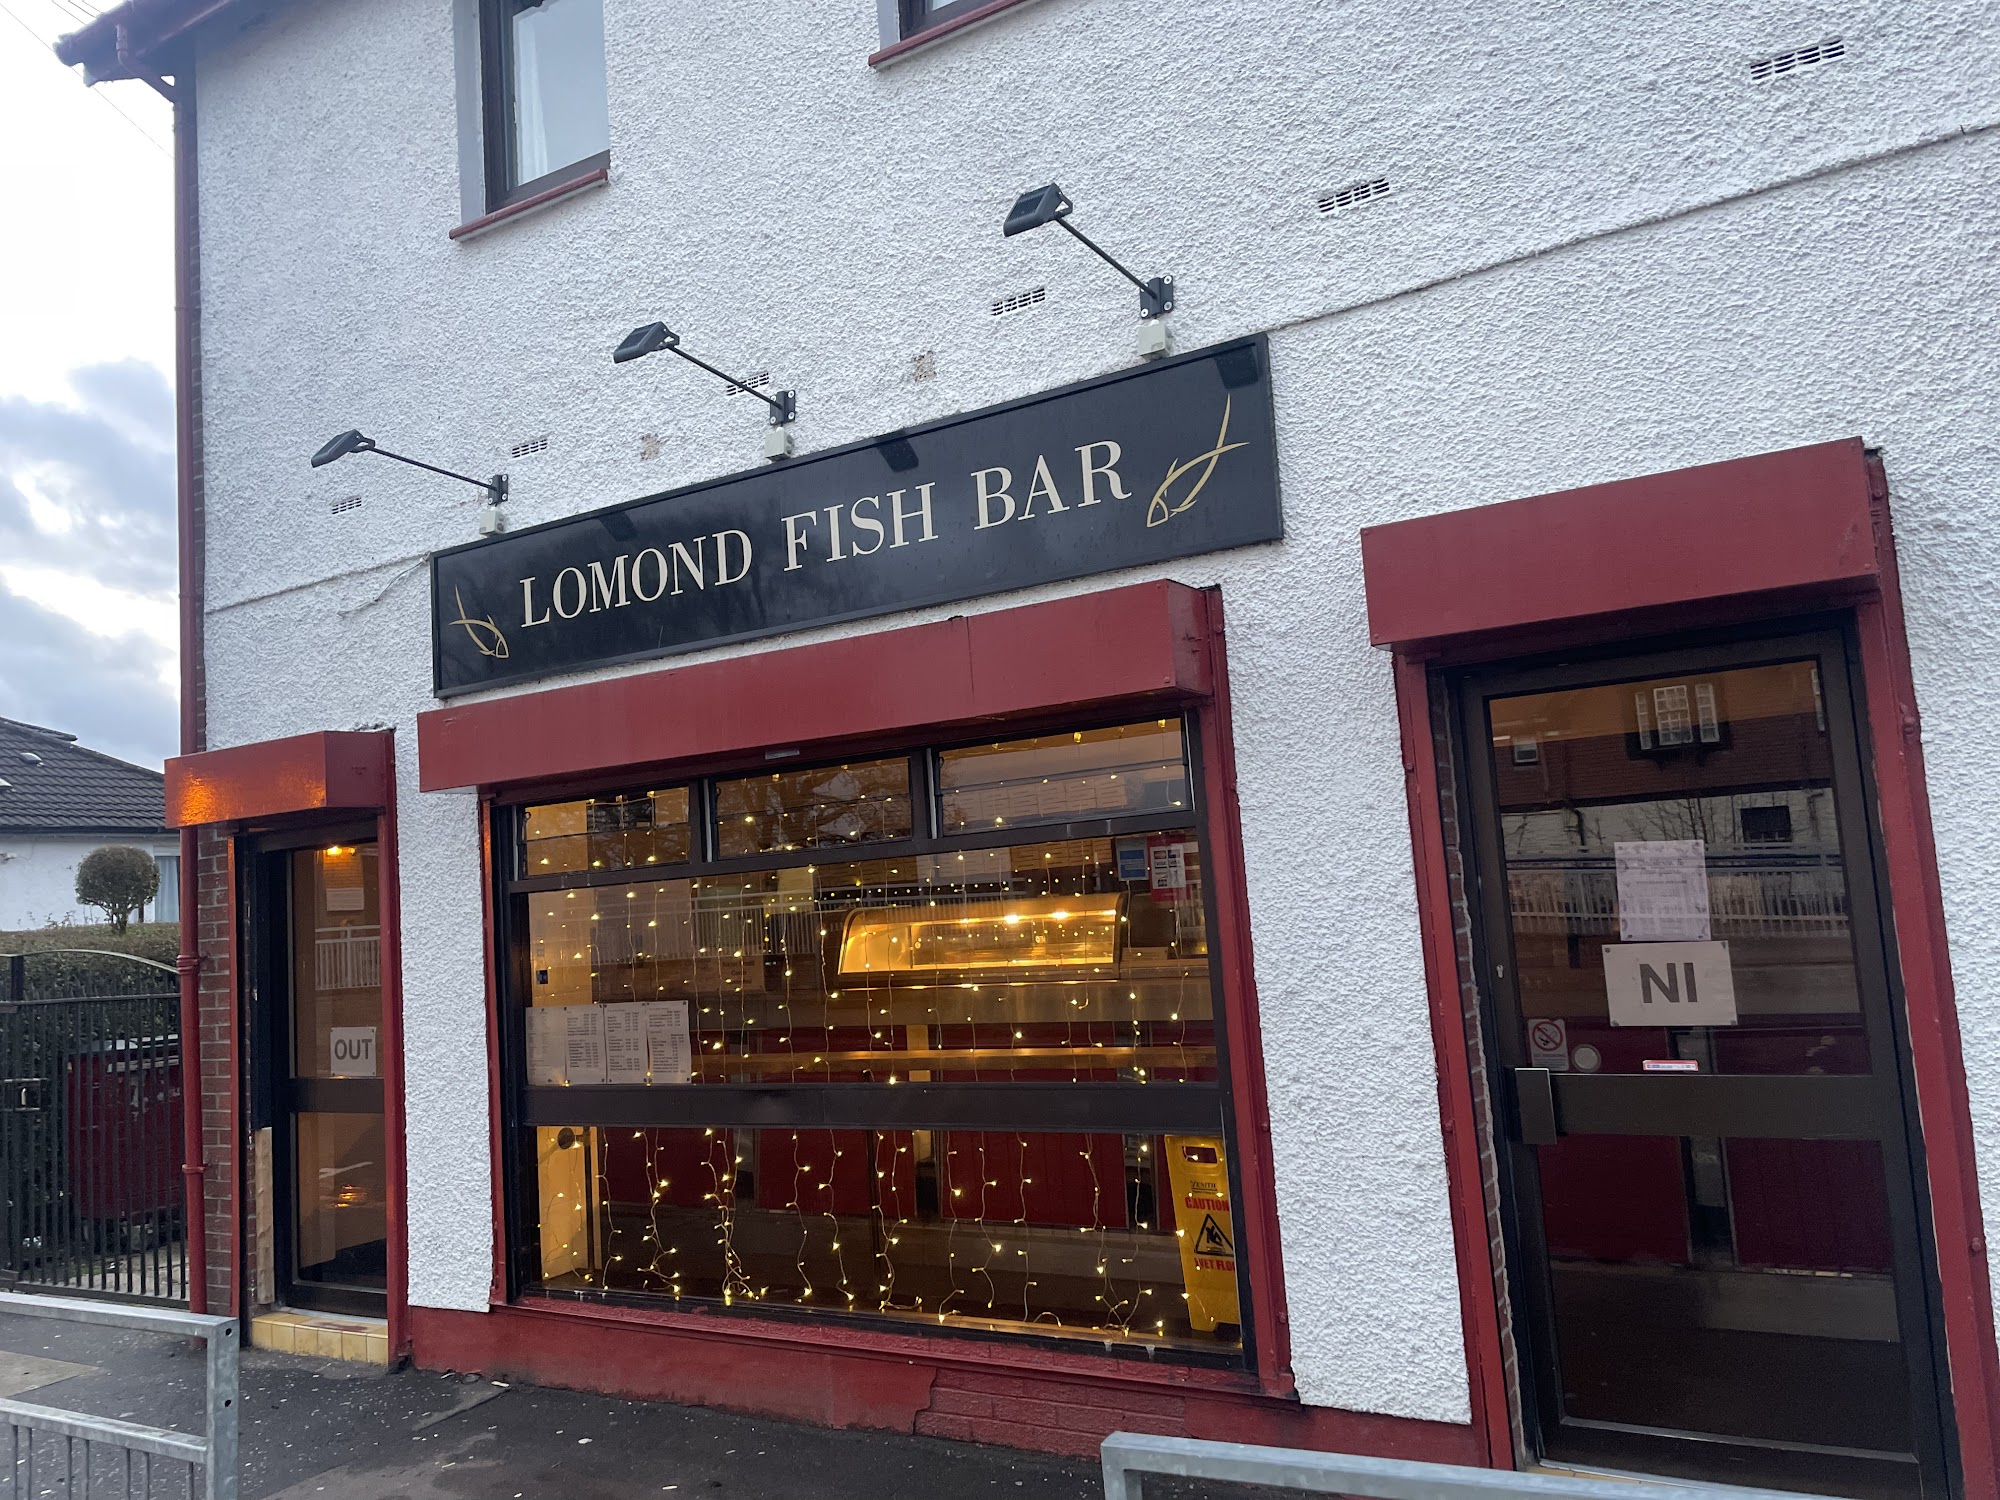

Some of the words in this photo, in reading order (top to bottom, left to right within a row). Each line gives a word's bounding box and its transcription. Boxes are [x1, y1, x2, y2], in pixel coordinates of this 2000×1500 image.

[519, 529, 753, 628] LOMOND
[780, 482, 939, 572] FISH
[970, 440, 1132, 531] BAR
[334, 1038, 373, 1061] OUT
[1190, 1181, 1216, 1189] ZENITH
[1185, 1197, 1229, 1211] CAUTION
